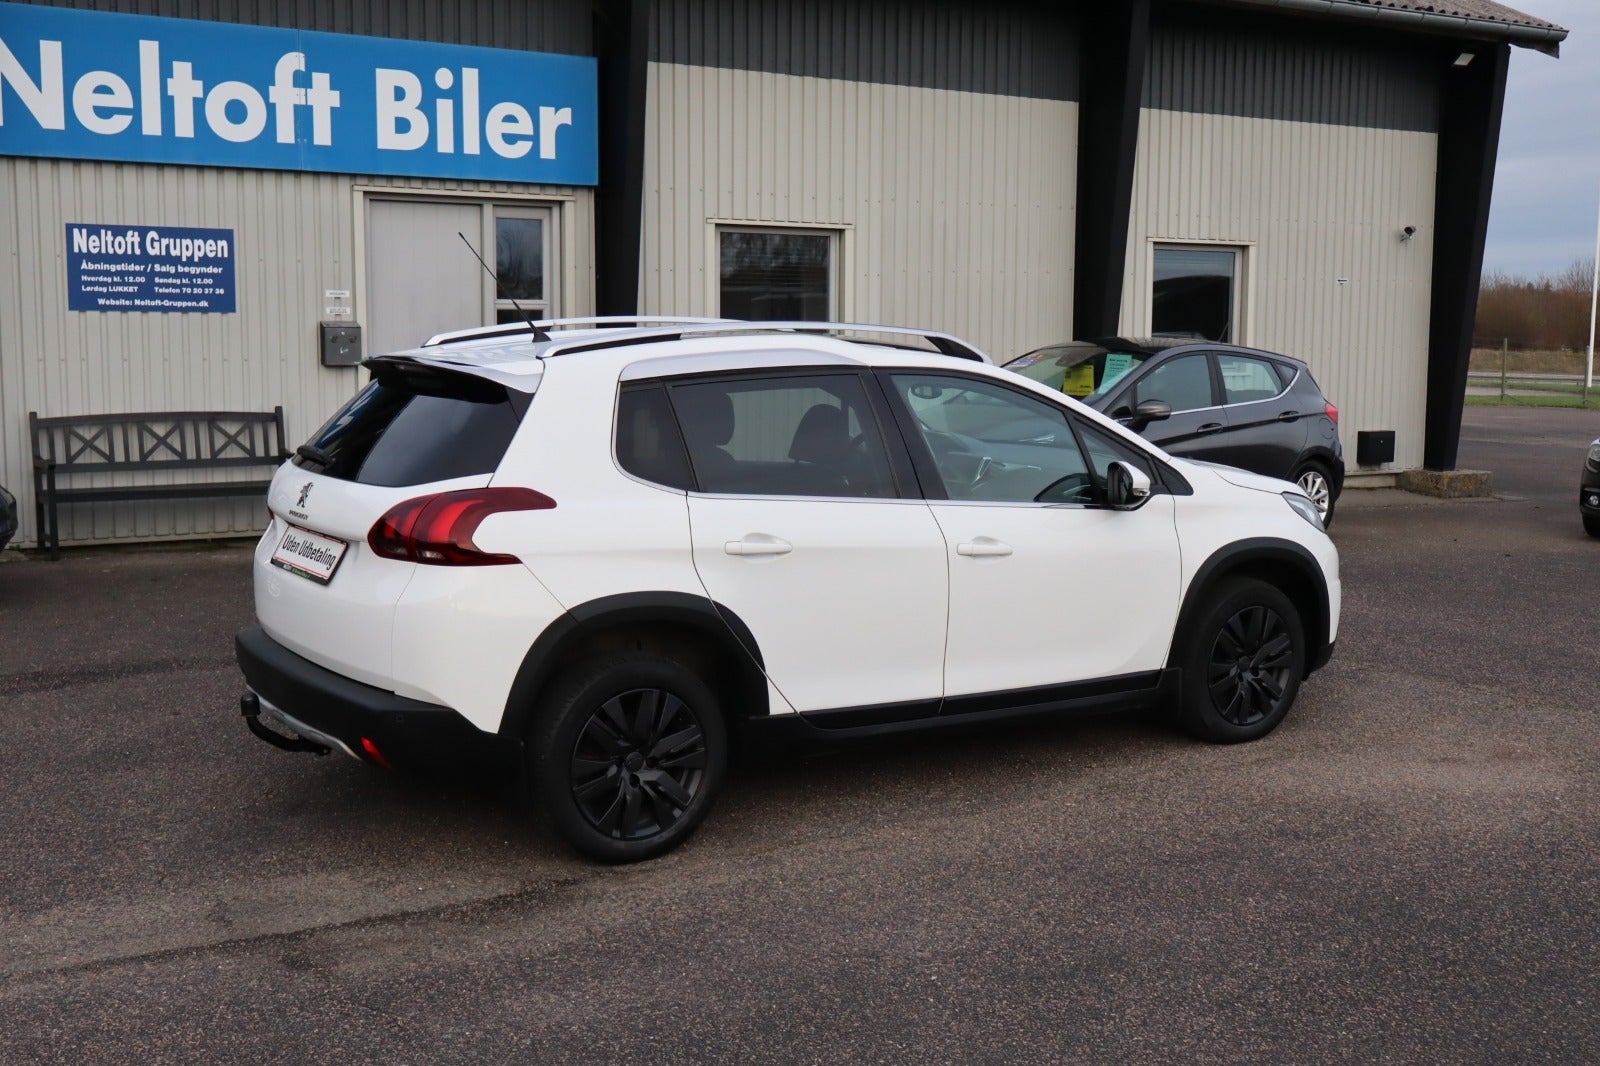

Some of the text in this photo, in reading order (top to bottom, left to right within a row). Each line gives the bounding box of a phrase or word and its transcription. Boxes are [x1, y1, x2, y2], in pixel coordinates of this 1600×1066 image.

[0, 38, 572, 160] Neltoft Biler
[73, 228, 228, 262] Neltoft Gruppen
[80, 259, 223, 275] Åbningstider / Salg begynder
[81, 275, 112, 283] Hverdag
[97, 298, 209, 308] Website: Neltoft-Gruppen.dk
[282, 534, 336, 571] Uden Udbetaling
